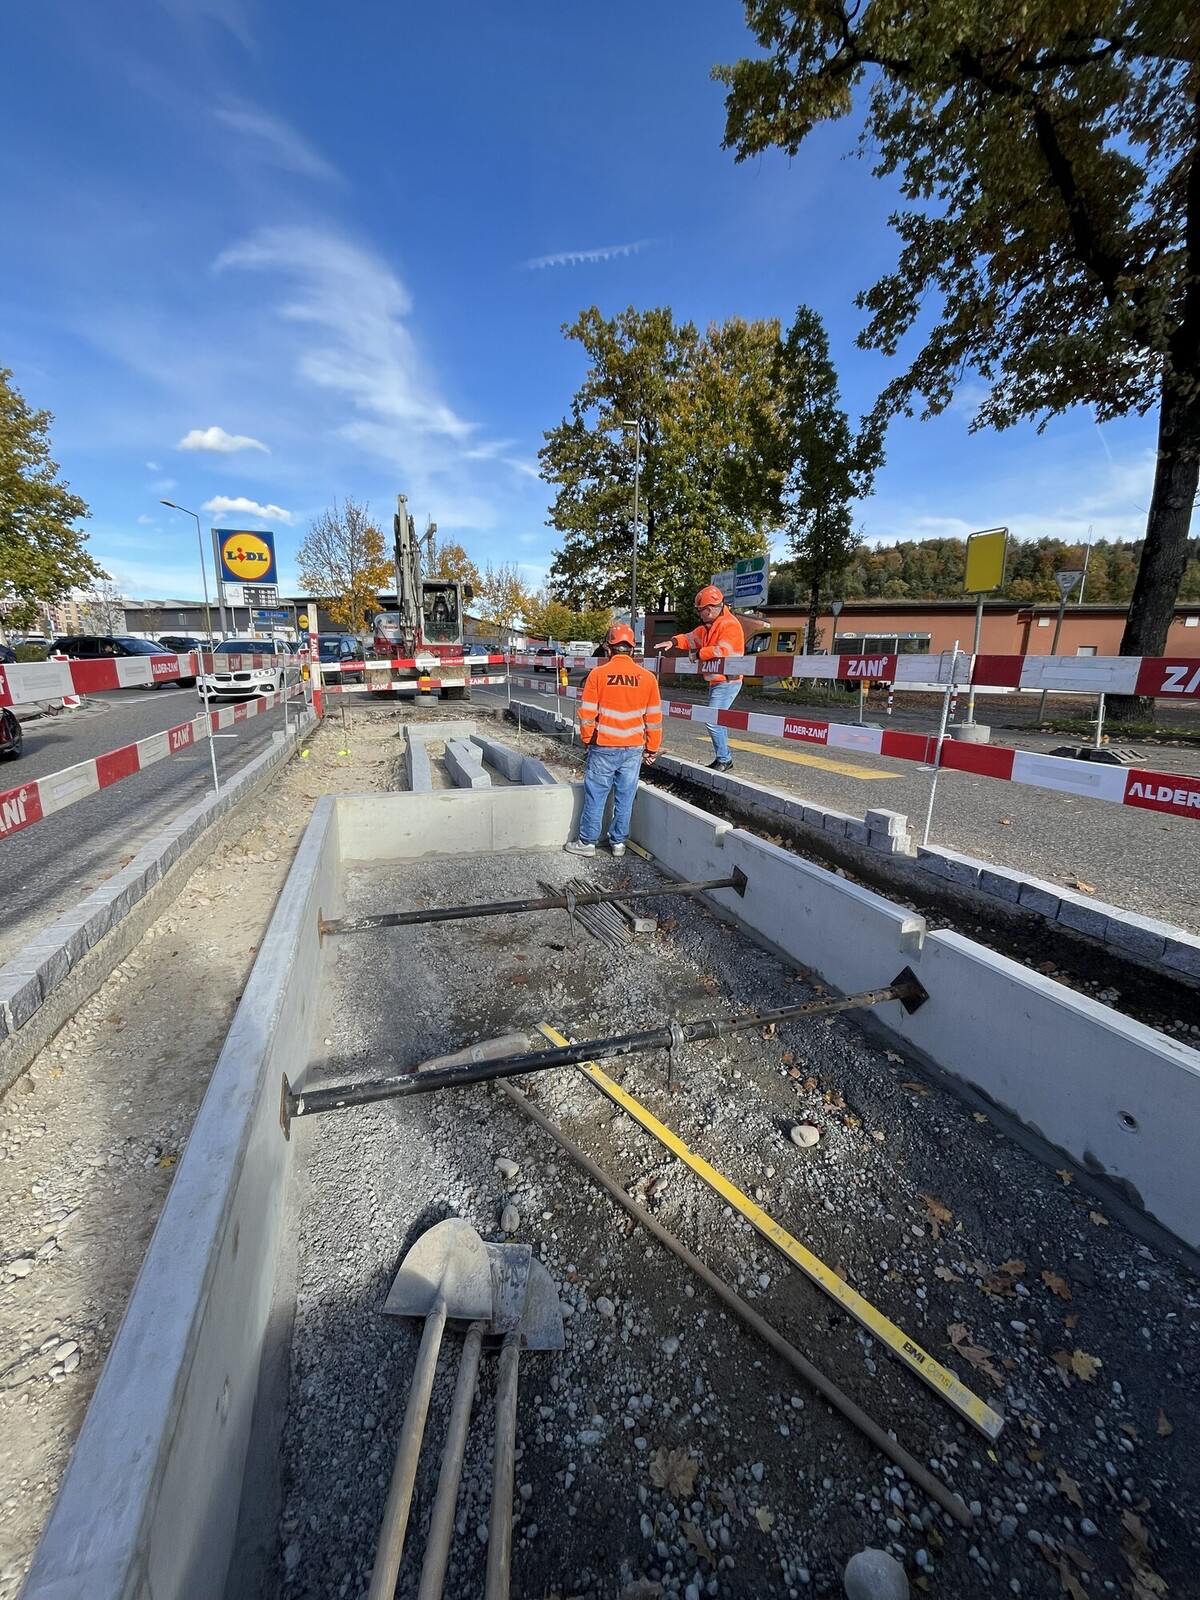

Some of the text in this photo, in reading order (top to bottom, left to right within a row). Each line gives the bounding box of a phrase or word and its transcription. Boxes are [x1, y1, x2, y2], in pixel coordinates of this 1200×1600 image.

[152, 660, 179, 675] ALDER-ZANI
[702, 658, 721, 673] ZANI
[847, 656, 888, 677] ZANI
[606, 674, 642, 687] ZANI
[172, 727, 191, 749] ZANI
[784, 723, 828, 739] ALDER-ZANI
